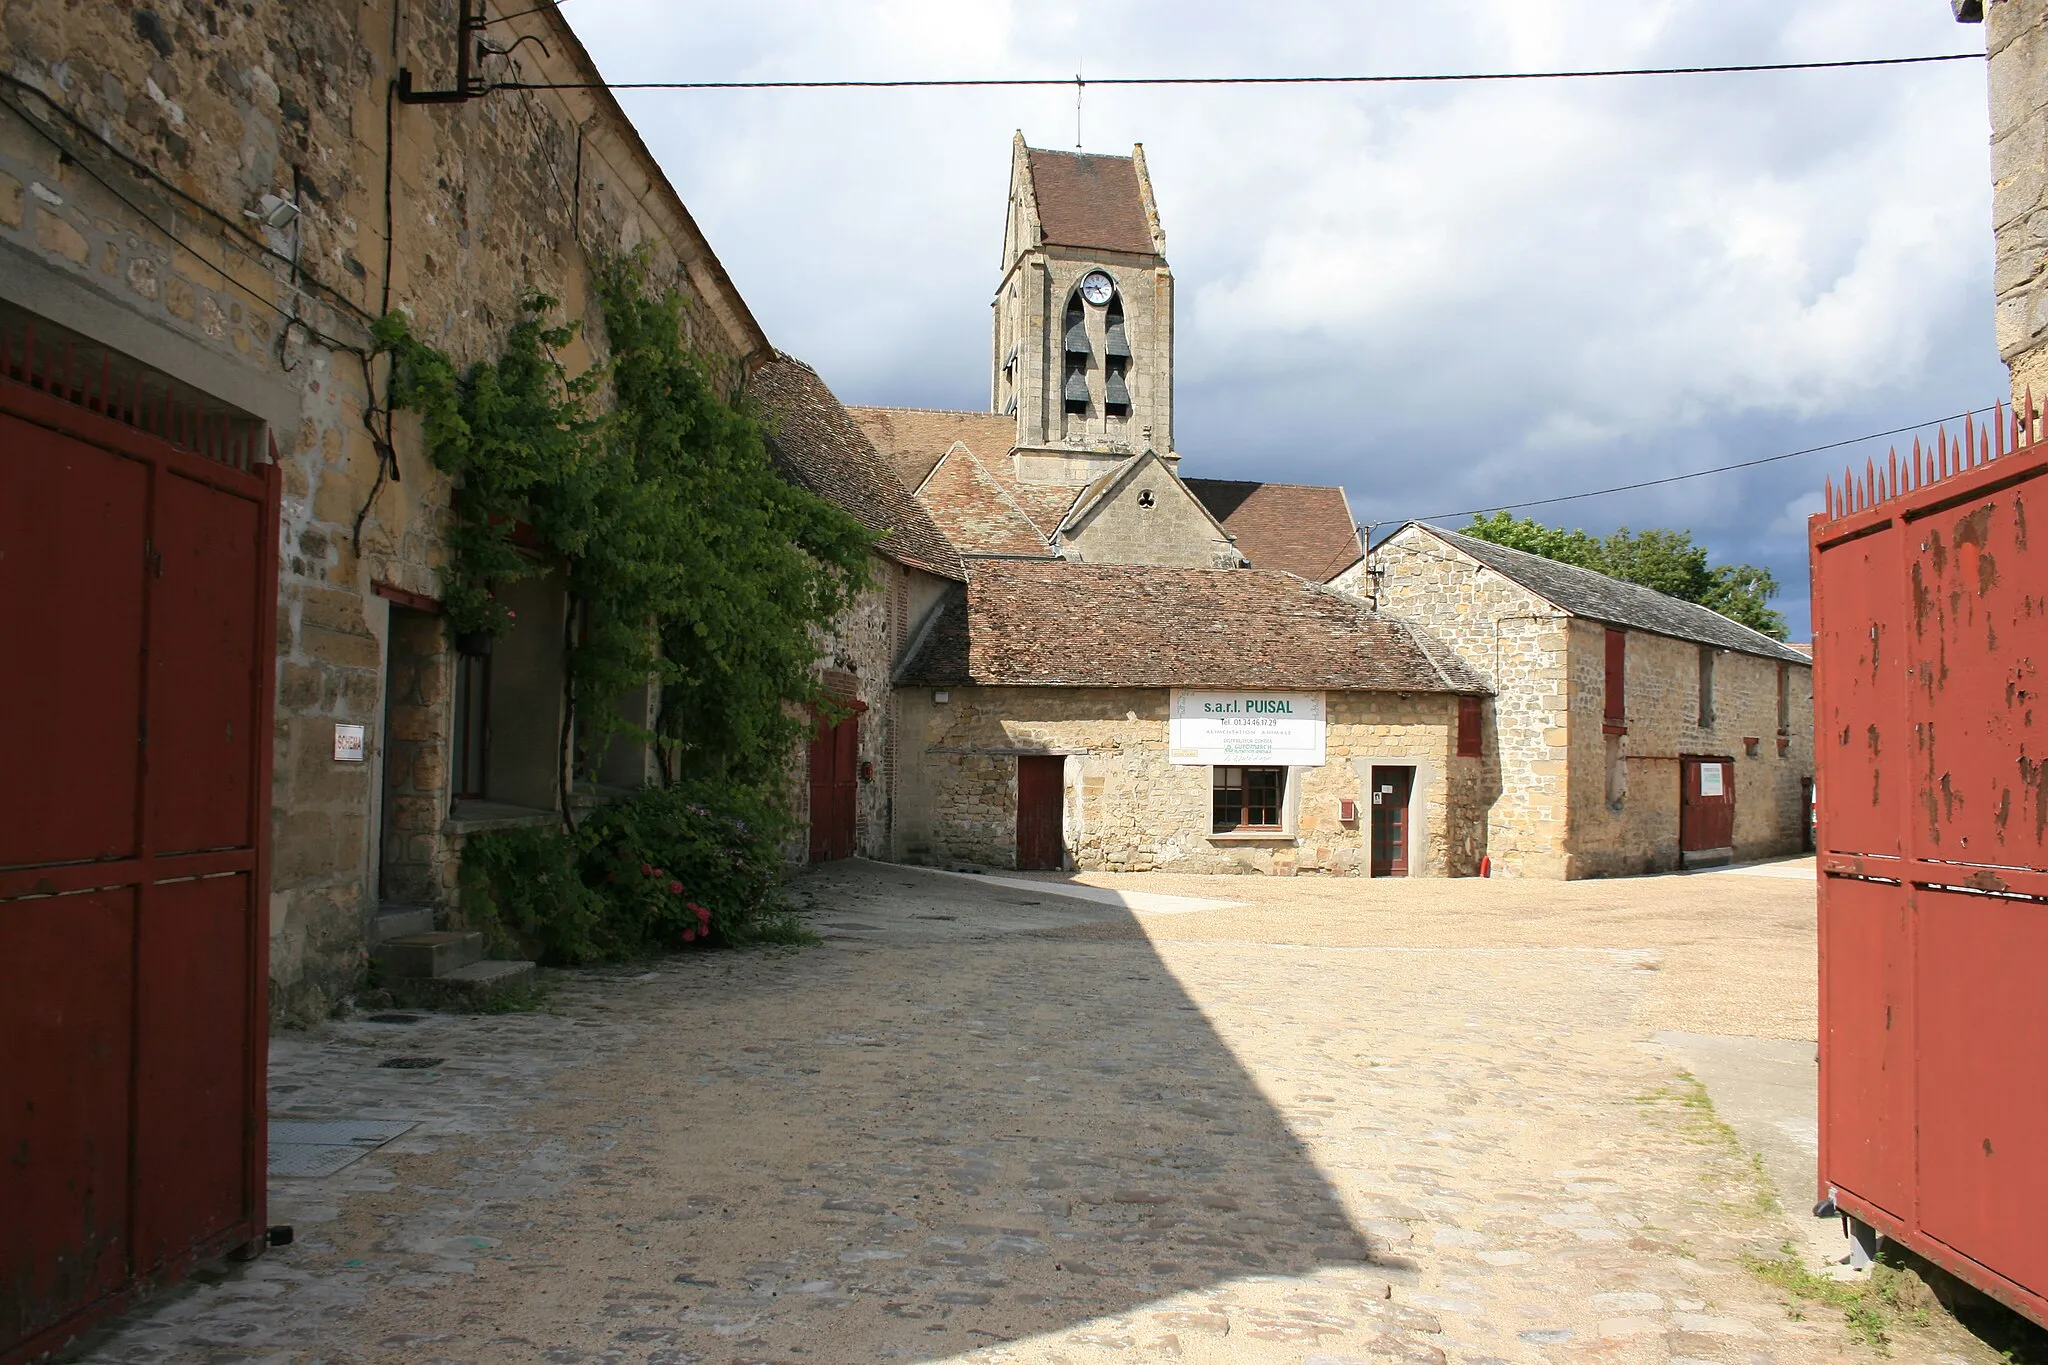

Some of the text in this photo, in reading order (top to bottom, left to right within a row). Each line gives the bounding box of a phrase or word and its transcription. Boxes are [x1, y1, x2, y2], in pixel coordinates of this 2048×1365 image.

[1204, 700, 1293, 713] s.a.r.l. PUISAL
[1233, 718, 1277, 727] 01.34.46.17.29
